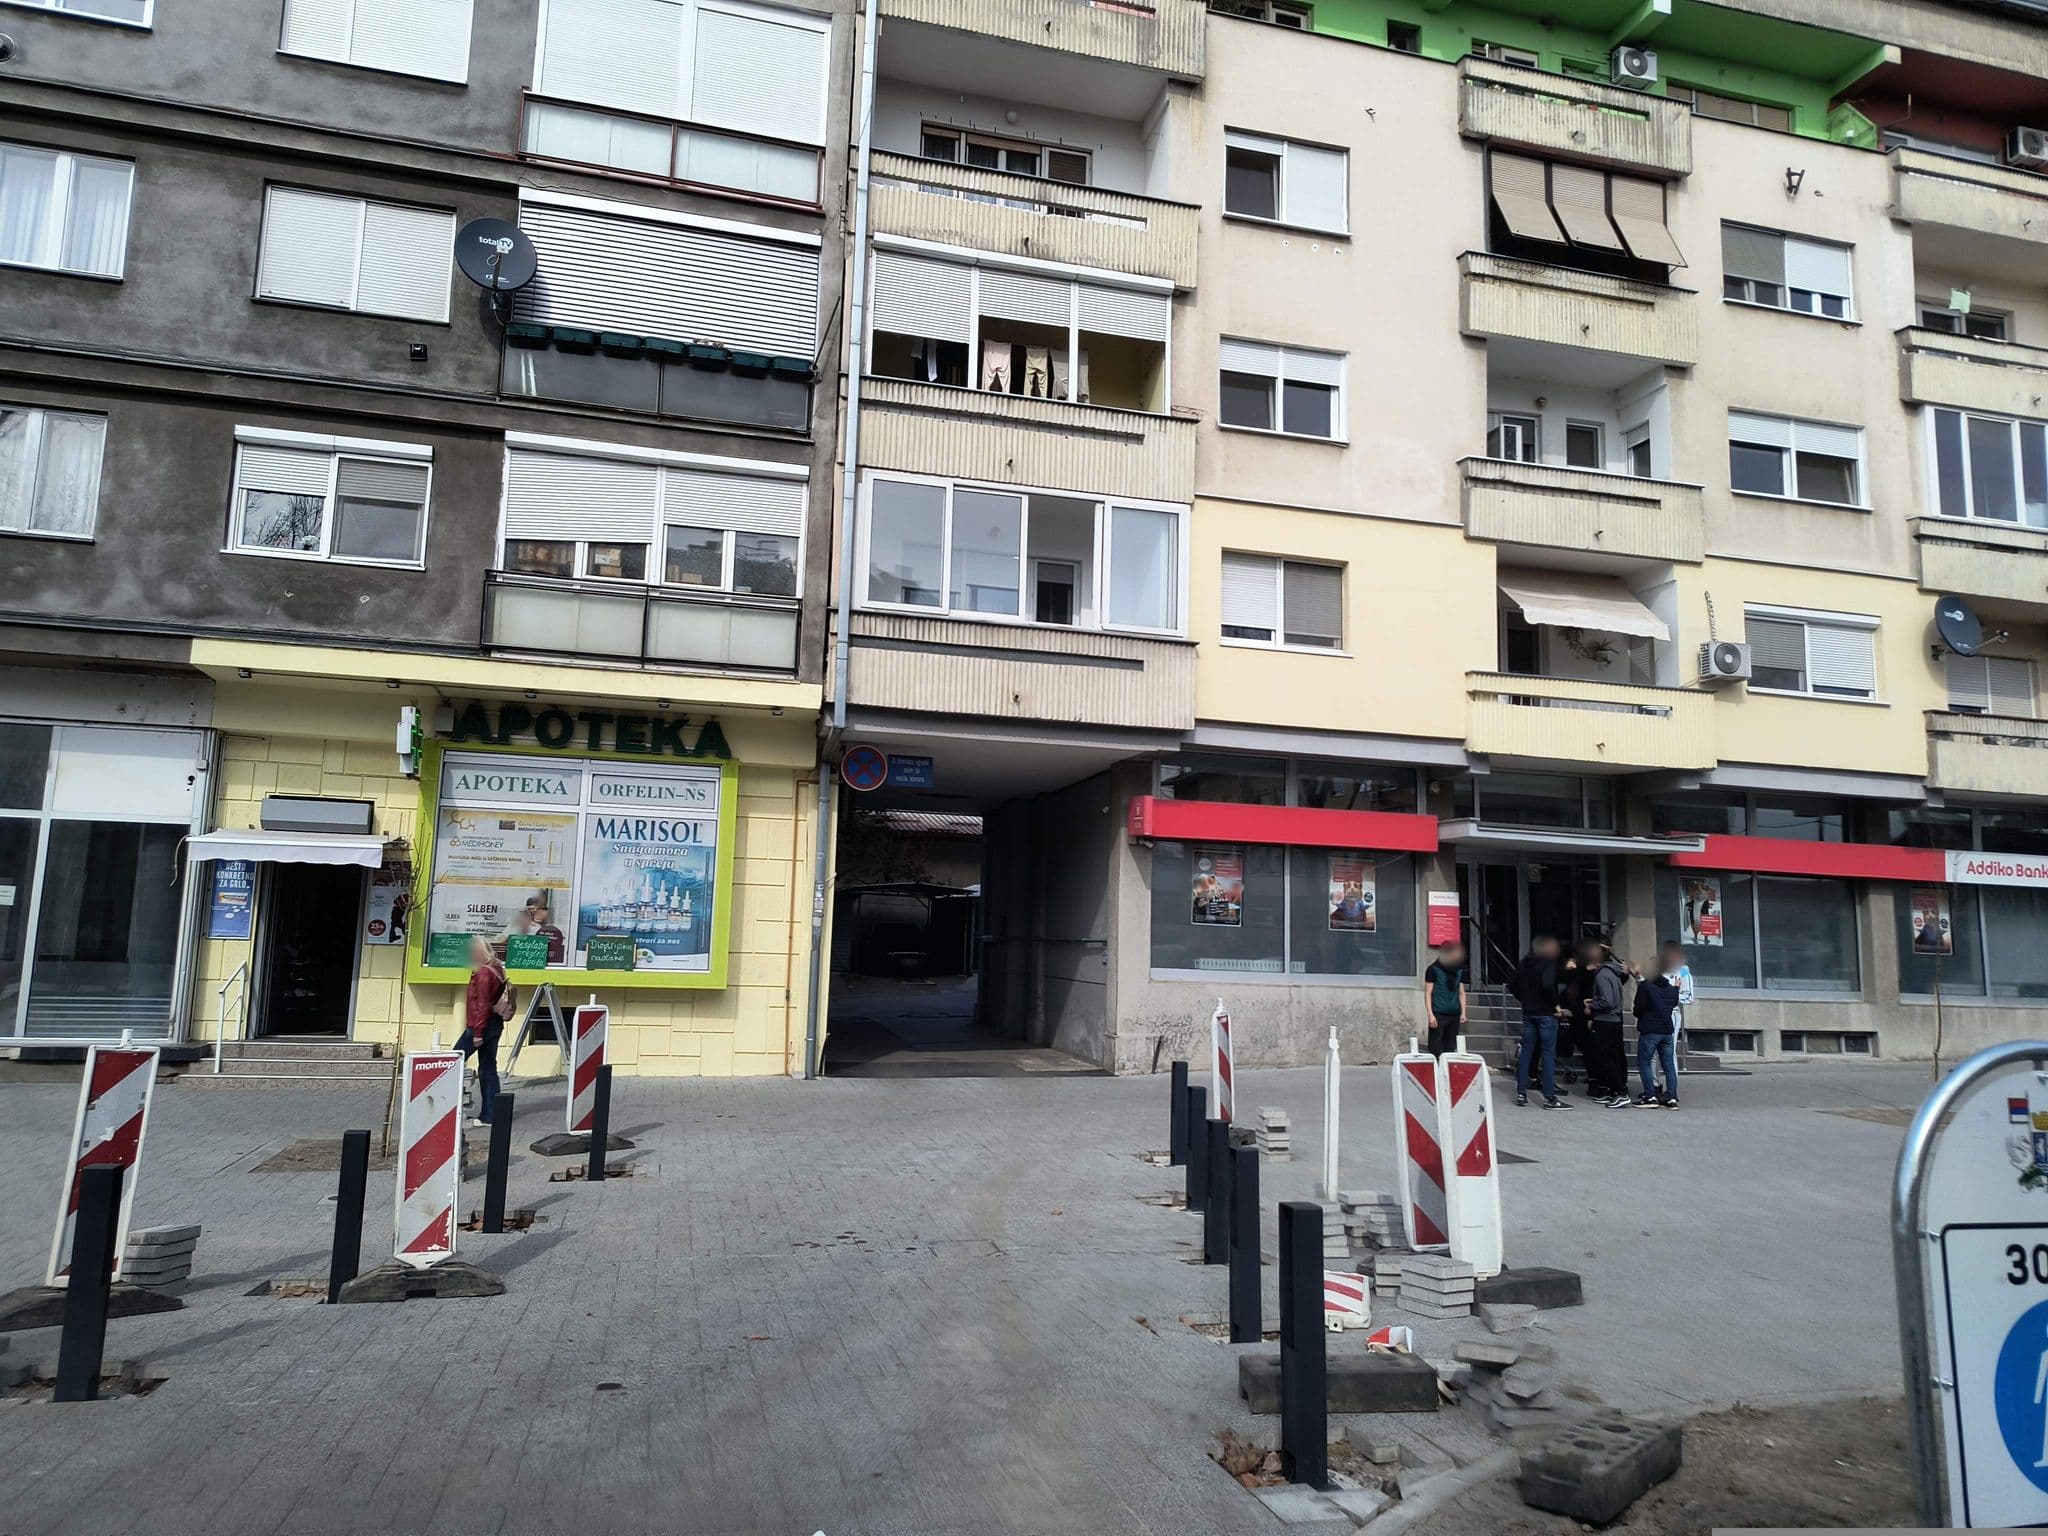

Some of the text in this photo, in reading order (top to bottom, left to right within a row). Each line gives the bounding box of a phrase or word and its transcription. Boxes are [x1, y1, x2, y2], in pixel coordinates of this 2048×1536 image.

[450, 702, 732, 758] APOTEKA
[455, 774, 569, 796] APOTEKA
[595, 818, 702, 843] MARISOL
[612, 843, 689, 857] Snaga mora
[624, 857, 676, 869] u spreju
[1966, 860, 2048, 878] Addiko Bank
[219, 879, 228, 888] ZA
[466, 904, 498, 914] SILBEN
[415, 1060, 455, 1070] montop
